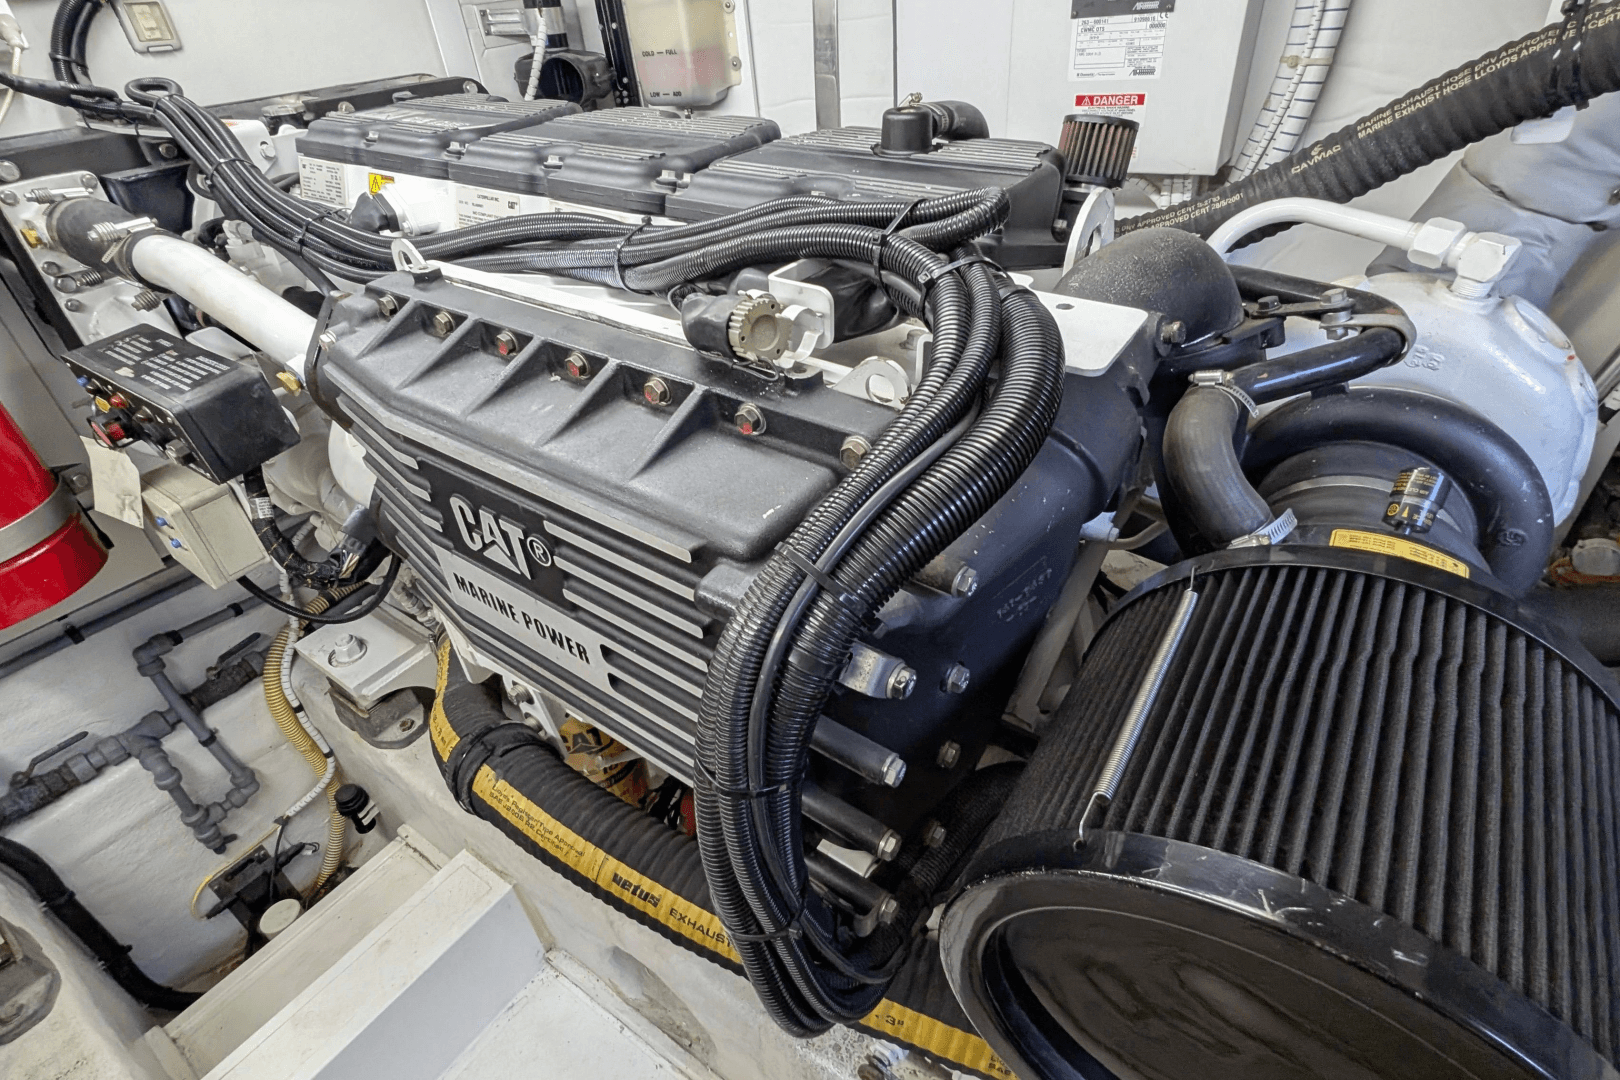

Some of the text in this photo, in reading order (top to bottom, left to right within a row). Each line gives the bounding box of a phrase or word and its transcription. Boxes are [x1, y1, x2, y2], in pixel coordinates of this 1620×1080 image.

[1093, 95, 1139, 106] DANGER
[1357, 109, 1393, 131] MARINE
[1393, 83, 1441, 111] EXHAUST
[1442, 67, 1472, 86] HOSE
[1474, 56, 1498, 72] DNV
[1358, 116, 1394, 139] MARINE
[1395, 91, 1442, 119] EXHAUST
[1442, 76, 1472, 96] HOSE
[1474, 54, 1518, 81] LLOYDS
[1291, 144, 1342, 174] CAVMAC
[1137, 211, 1175, 228] APPROVED
[1176, 204, 1196, 216] CERT
[1190, 206, 1210, 219] CERT
[453, 572, 591, 665] MARINE POWER
